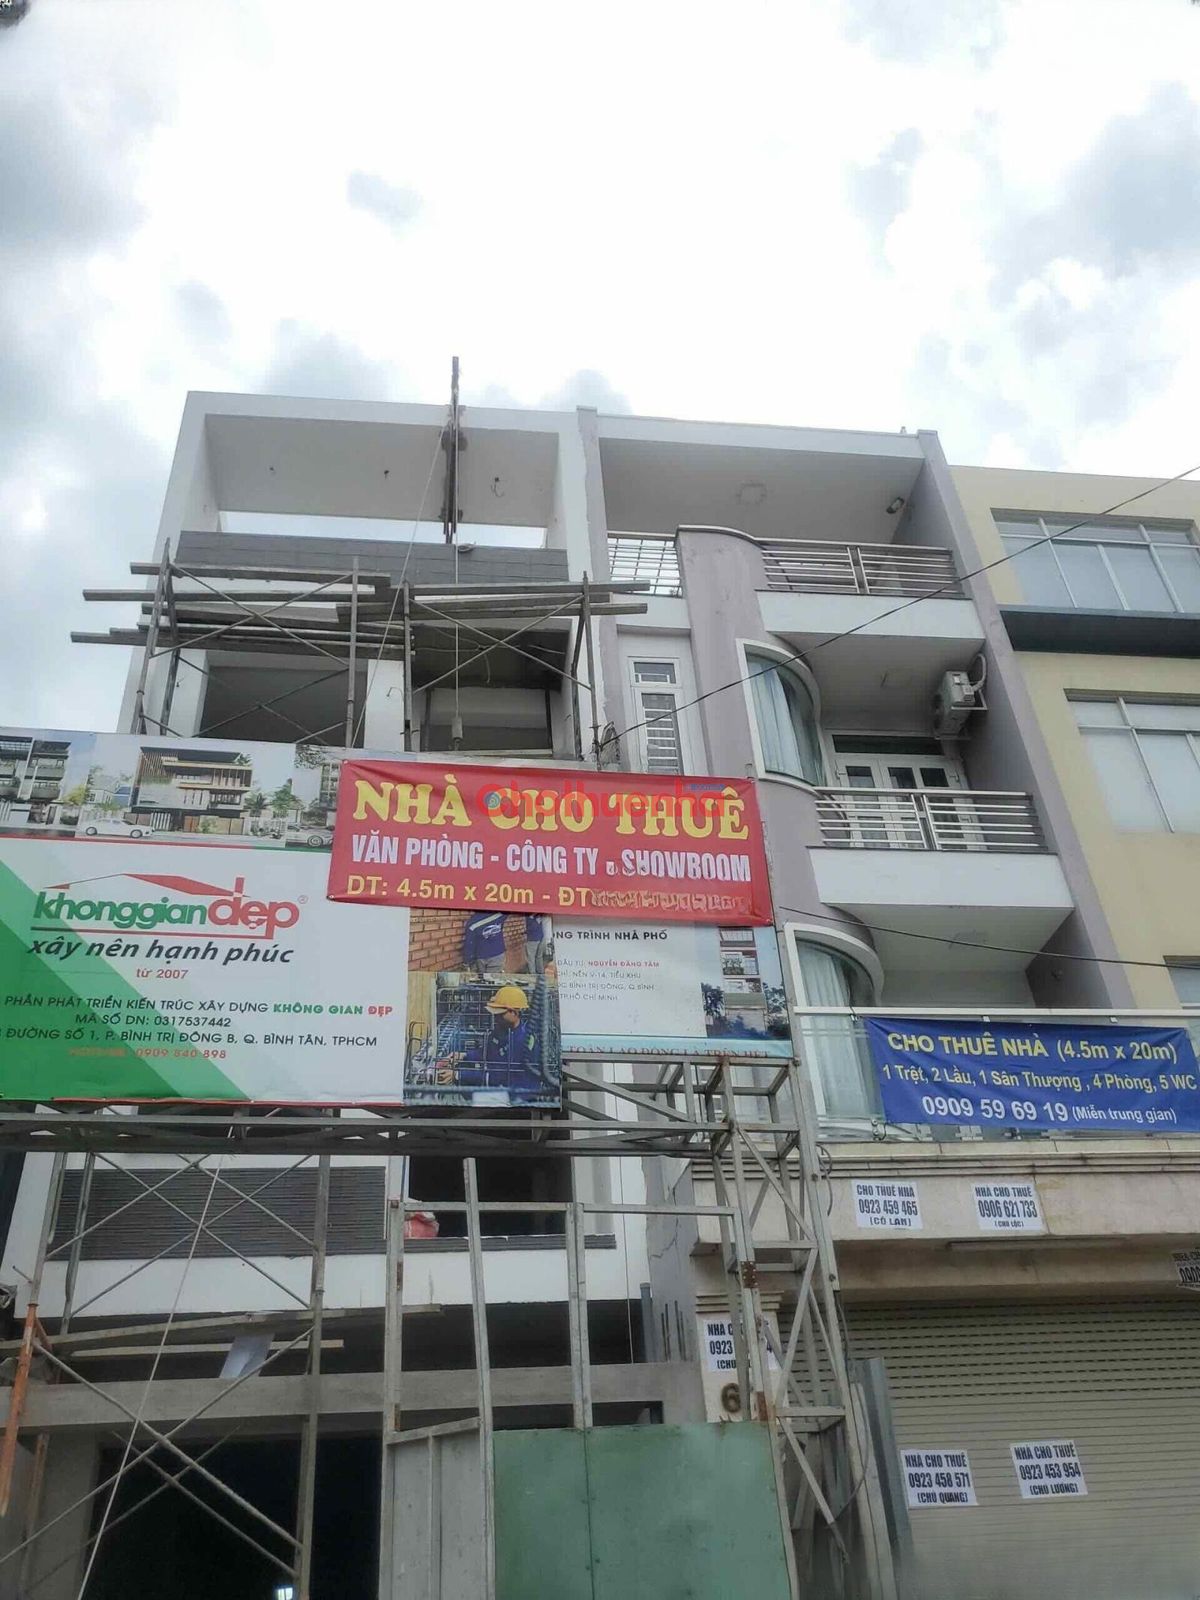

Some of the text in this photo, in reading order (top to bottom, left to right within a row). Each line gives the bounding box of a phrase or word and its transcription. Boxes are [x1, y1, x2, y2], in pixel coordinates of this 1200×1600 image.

[353, 773, 750, 840] NHÀ CHO THUÊ
[352, 829, 399, 864] VĂN
[405, 833, 484, 869] PHÒNG
[506, 839, 567, 875] CÔNG
[573, 847, 599, 876] TY
[346, 875, 388, 896] DT:
[397, 878, 455, 899] 4.5m
[464, 885, 477, 901] x
[484, 883, 534, 904] 20m
[643, 929, 668, 940] PHỐ
[27, 936, 295, 966] xây nên hạnh phúc
[156, 969, 189, 979] 2007
[273, 1002, 323, 1014] KHÔNG
[328, 1005, 363, 1015] GIAN
[367, 1005, 393, 1017] ĐẸP
[125, 1015, 150, 1025] DN:
[153, 1016, 232, 1027] 0317537442
[180, 1031, 222, 1043] ĐÔNG
[227, 1034, 238, 1044] B,
[243, 1034, 258, 1044] Q.
[332, 1036, 377, 1046] TPHCM
[203, 1049, 227, 1059] 898
[888, 1032, 1177, 1064] CHO THUÊ NHÀ (4.5m x 20m)
[883, 1065, 891, 1079] 1
[895, 1065, 929, 1084] Trệt,
[932, 1068, 941, 1081] 2
[945, 1065, 976, 1086] Lầu,
[979, 1070, 987, 1084] 1
[991, 1071, 1020, 1086] Sân
[1022, 1072, 1083, 1092] Thượng
[1093, 1074, 1102, 1088] 4
[1105, 1074, 1157, 1093] Phòng,
[1160, 1075, 1169, 1089] 5
[1171, 1075, 1197, 1090] WC
[922, 1096, 1177, 1123] 0909 59 69 19 (Miễn trung gian)
[856, 1184, 874, 1196] CHO
[993, 1186, 1010, 1197] CHO
[859, 1199, 918, 1216] 0923 459 465
[978, 1200, 1037, 1217] 0906 621 733
[709, 1340, 733, 1354] 0923
[1034, 1445, 1053, 1459] CHO
[925, 1454, 943, 1468] CHO
[1019, 1462, 1081, 1480] 0923 453 954
[908, 1472, 971, 1488] 0923 458 571
